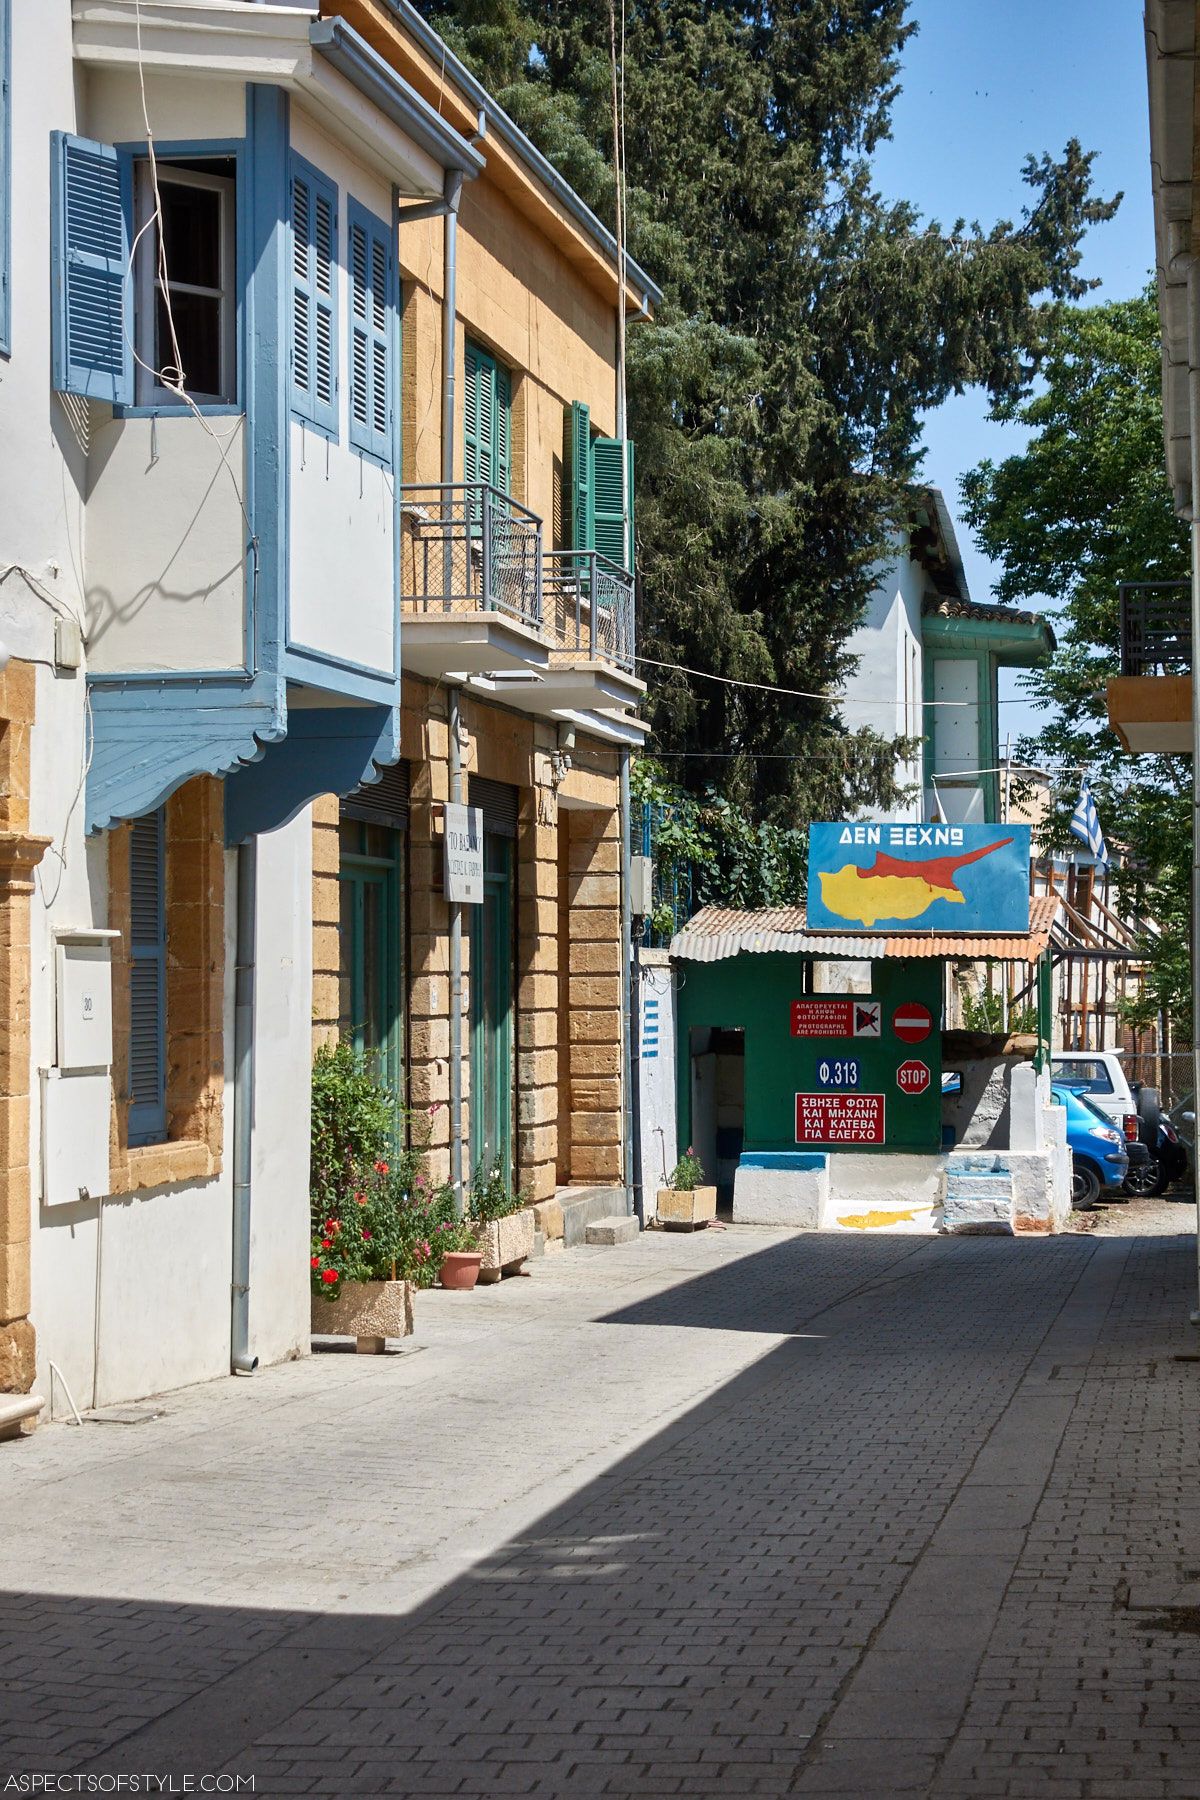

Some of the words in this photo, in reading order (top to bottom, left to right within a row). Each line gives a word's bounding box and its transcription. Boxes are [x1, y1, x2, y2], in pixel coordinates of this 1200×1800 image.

[839, 827, 880, 844] ΔΕΝ
[890, 827, 964, 846] ΞΕΧΝΩ
[819, 1062, 857, 1084] Φ.313
[900, 1069, 926, 1085] STOP
[802, 1098, 840, 1108] ΣΒΗΣΕ
[846, 1098, 878, 1108] ΦΩΤΑ
[803, 1109, 822, 1118] ΚΑΙ
[828, 1109, 877, 1118] ΜΗΧΑΝΗ
[804, 1119, 824, 1128] ΚΑΙ
[831, 1119, 875, 1129] ΚΑΤΕΒΑ
[804, 1129, 822, 1139] ΓΙΑ
[829, 1129, 876, 1139] ΕΛΕΓΧΟ
